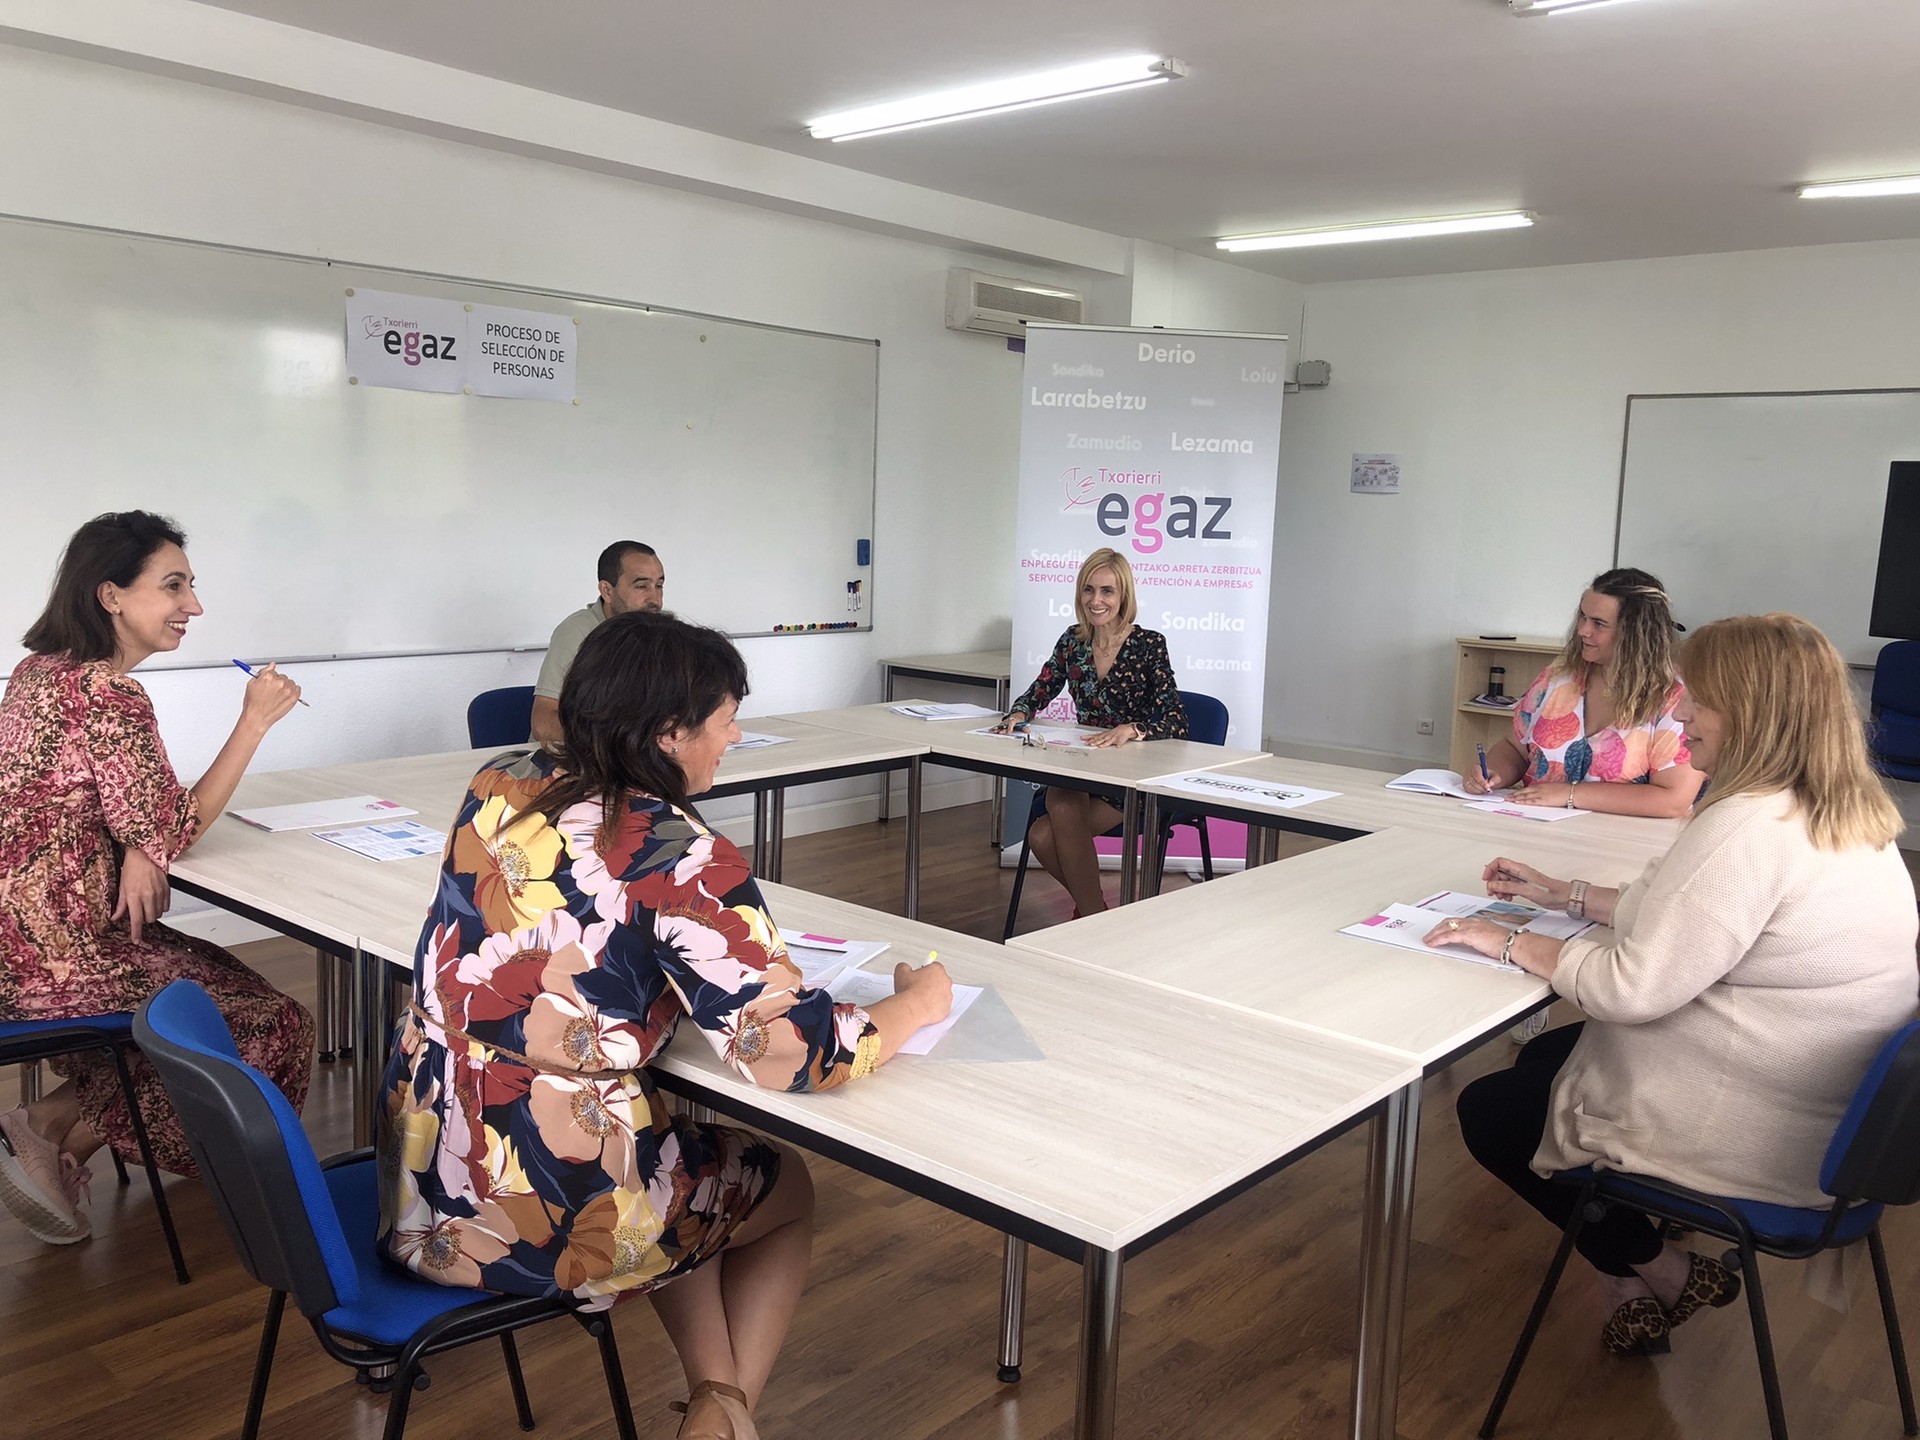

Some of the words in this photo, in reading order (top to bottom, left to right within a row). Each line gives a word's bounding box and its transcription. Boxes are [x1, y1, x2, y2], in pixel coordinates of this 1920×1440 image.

[383, 316, 418, 329] Txorierri
[486, 323, 541, 342] PROCESO
[545, 331, 560, 344] DE
[383, 329, 457, 366] egaz
[481, 341, 546, 361] SELECCIÓN
[550, 350, 565, 363] DE
[1138, 343, 1196, 364] Derio
[493, 361, 554, 380] PERSONAS
[1052, 362, 1104, 379] Sondika
[1241, 367, 1277, 383] Loiu
[1031, 387, 1147, 410] Larrabetzu
[1066, 433, 1143, 452] Zamudio
[1171, 432, 1254, 454] Lezama
[1099, 469, 1161, 485] Txorierri
[1097, 492, 1232, 554] egaz
[1021, 559, 1066, 569] ENPLEGU
[1172, 564, 1209, 574] ARRETA
[1211, 566, 1261, 576] ZERBITZUA
[1029, 573, 1074, 583] SERVICIO
[1142, 576, 1192, 587] ATENCIÓN
[1194, 580, 1201, 588] A
[1203, 578, 1253, 589] EMPRESAS
[1161, 612, 1245, 633] Sondika
[1186, 655, 1250, 672] Lezama
